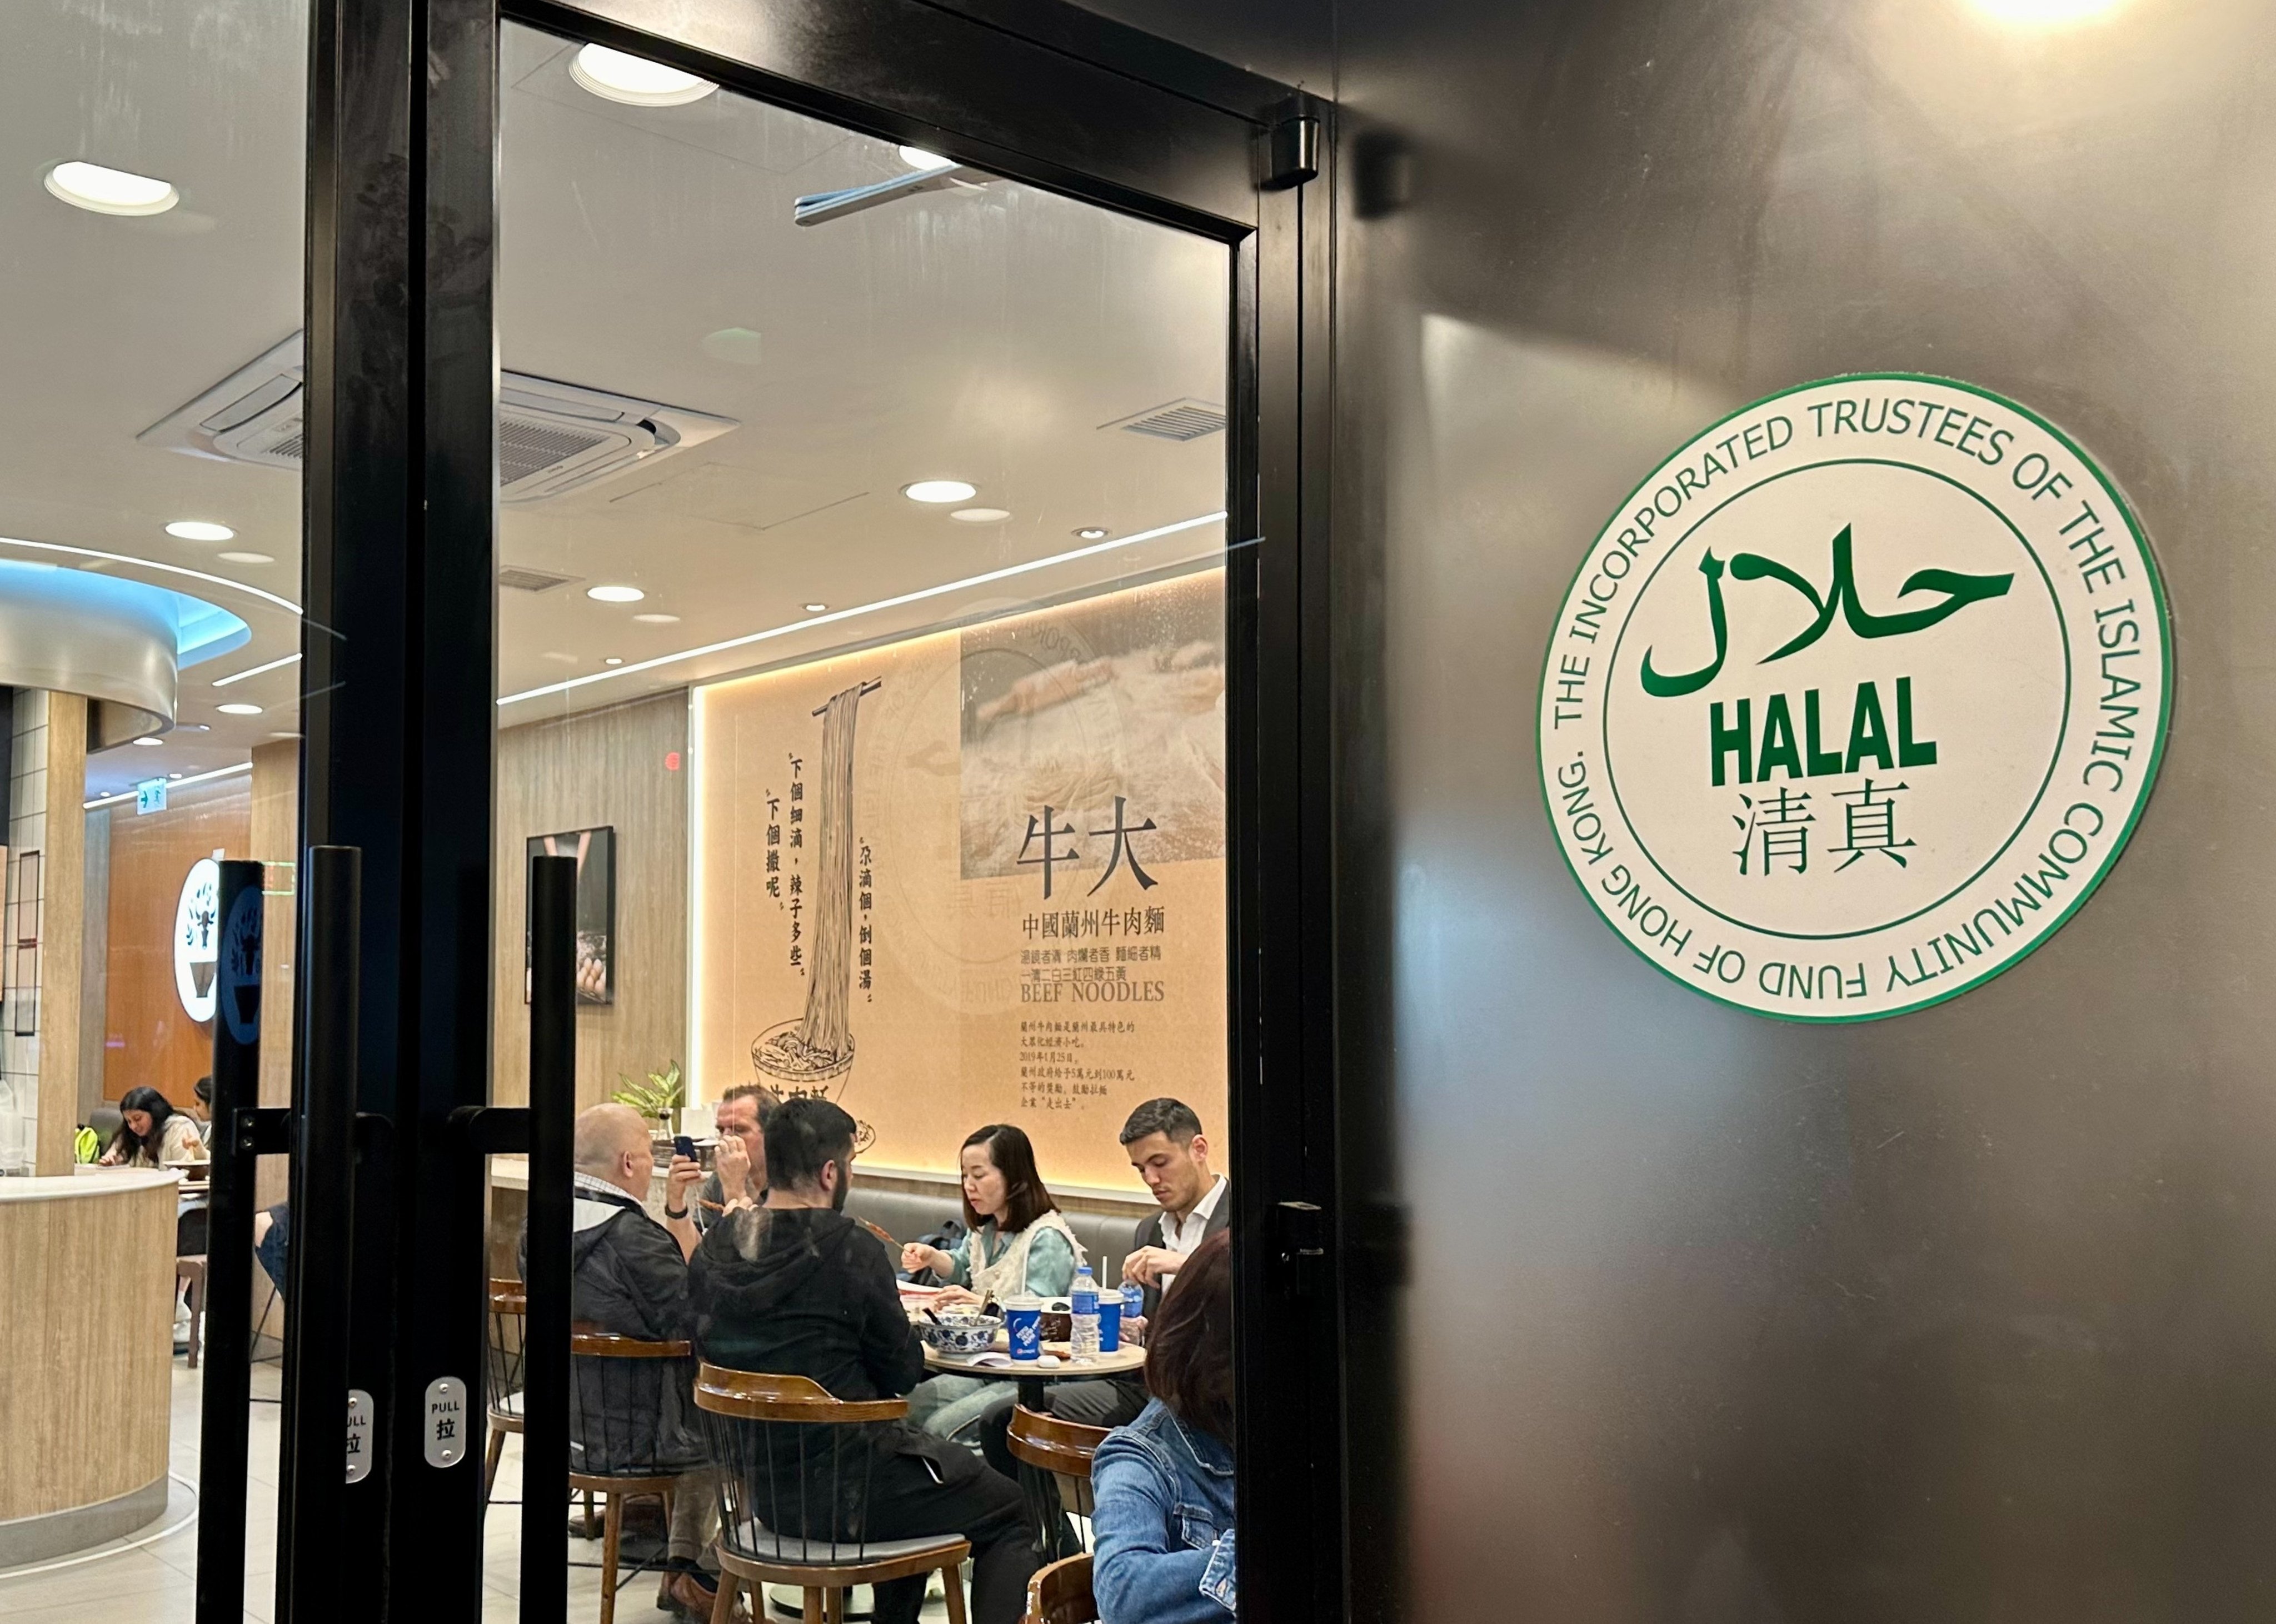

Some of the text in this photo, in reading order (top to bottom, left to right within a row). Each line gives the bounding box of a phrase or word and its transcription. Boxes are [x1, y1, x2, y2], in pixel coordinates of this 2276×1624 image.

[1640, 522, 2015, 697] حلال
[1554, 398, 2141, 999] THE INCORPORATED TRUSTEES OF THE ISLAMIC COMMUNITY FUND OF HONG KONG.
[1710, 676, 1938, 787] HALAL
[1016, 796, 1158, 900] 牛大
[1732, 778, 1917, 876] 清真
[1022, 906, 1165, 940] 中國蘭州牛肉麵
[1021, 981, 1165, 1002] BEEF NOODLES
[347, 1415, 366, 1427] ULL
[431, 1401, 460, 1414] PULL
[437, 1418, 455, 1441] 拉
